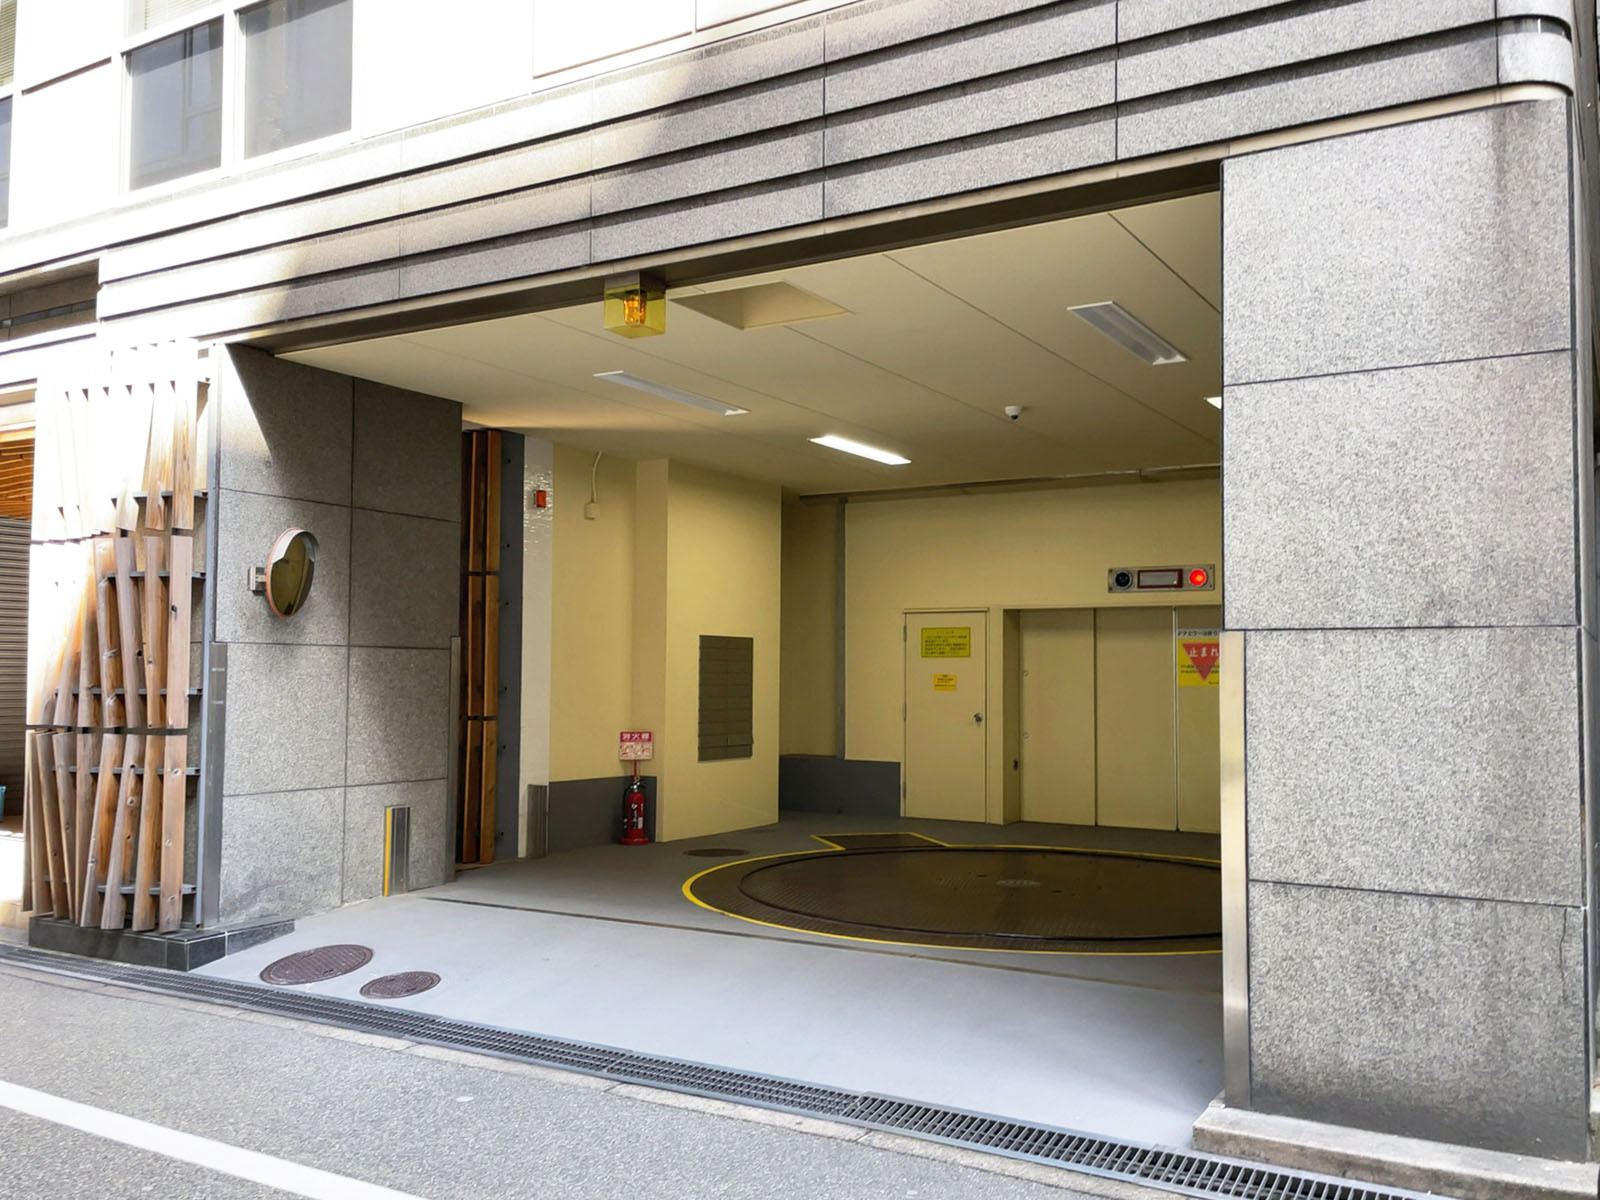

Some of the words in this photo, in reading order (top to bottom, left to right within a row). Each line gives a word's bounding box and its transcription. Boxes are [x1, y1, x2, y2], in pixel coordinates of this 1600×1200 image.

[1188, 647, 1219, 657] 止まれ
[622, 733, 650, 741] 消火器
